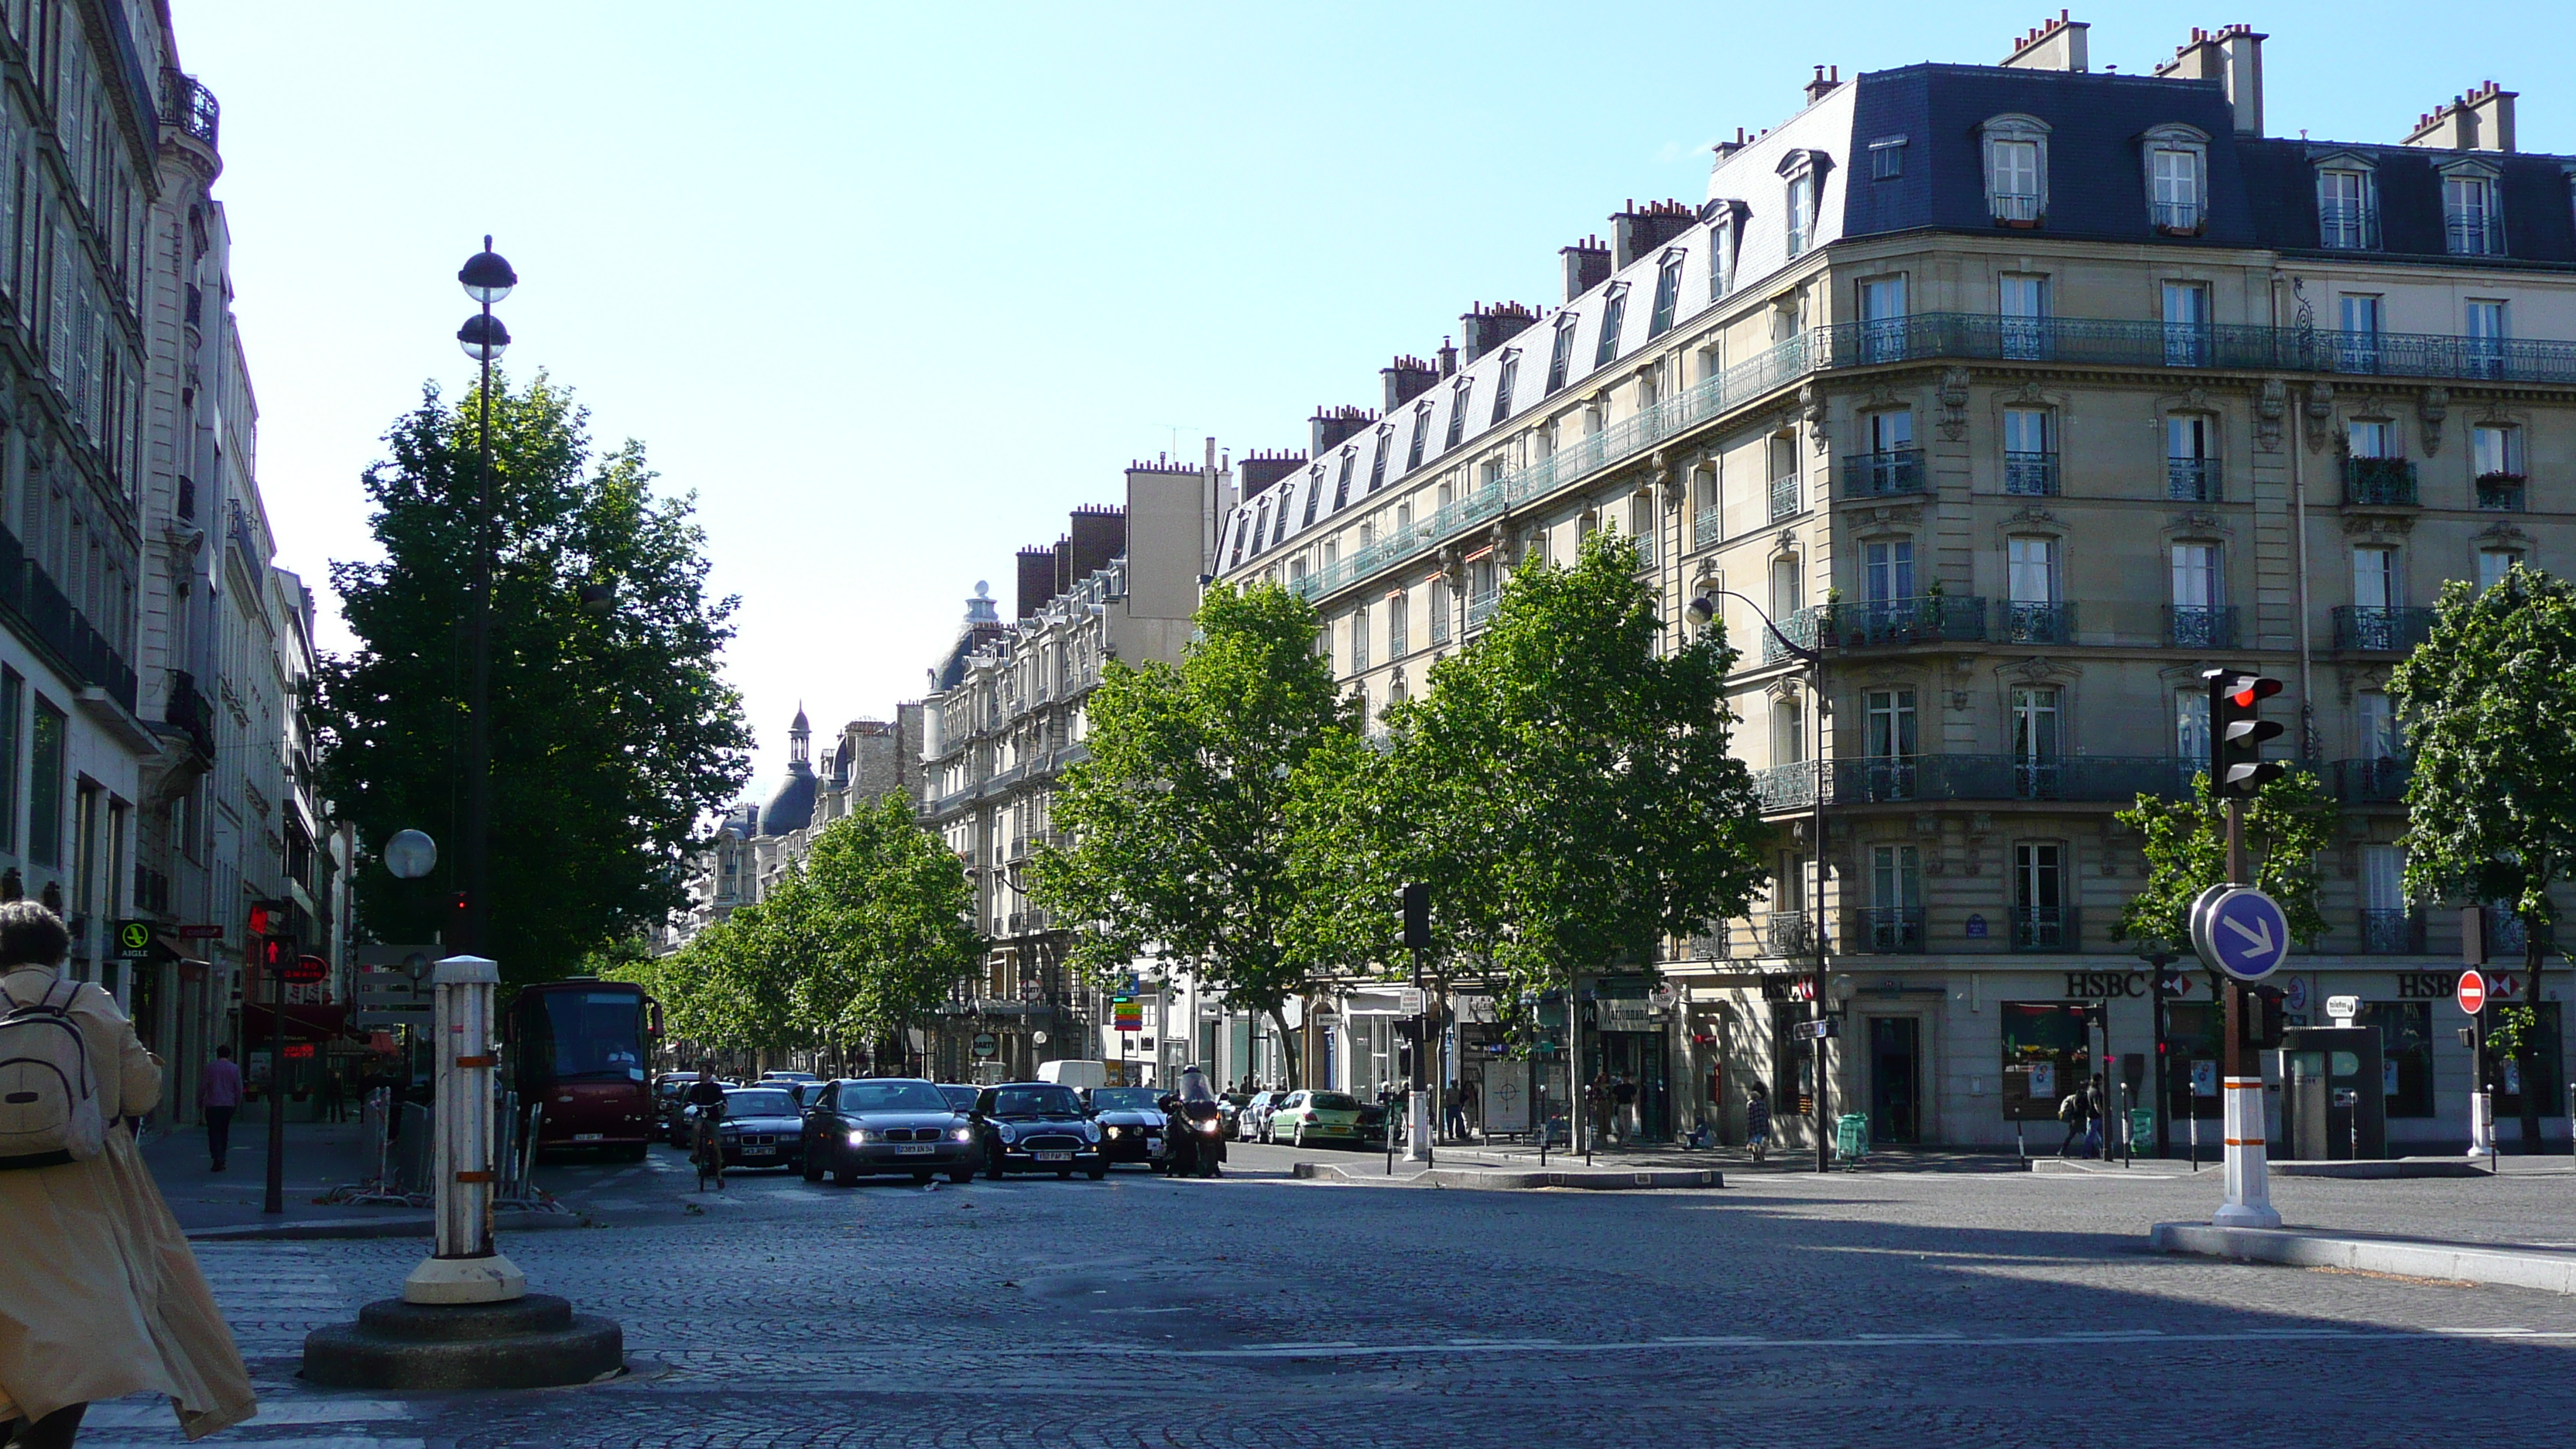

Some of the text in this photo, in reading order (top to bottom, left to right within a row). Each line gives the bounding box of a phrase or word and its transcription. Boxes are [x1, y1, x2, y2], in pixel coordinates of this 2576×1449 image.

[2065, 972, 2146, 998] HSBC
[2397, 975, 2458, 998] HSB
[1600, 1000, 1649, 1025] Marionnaud
